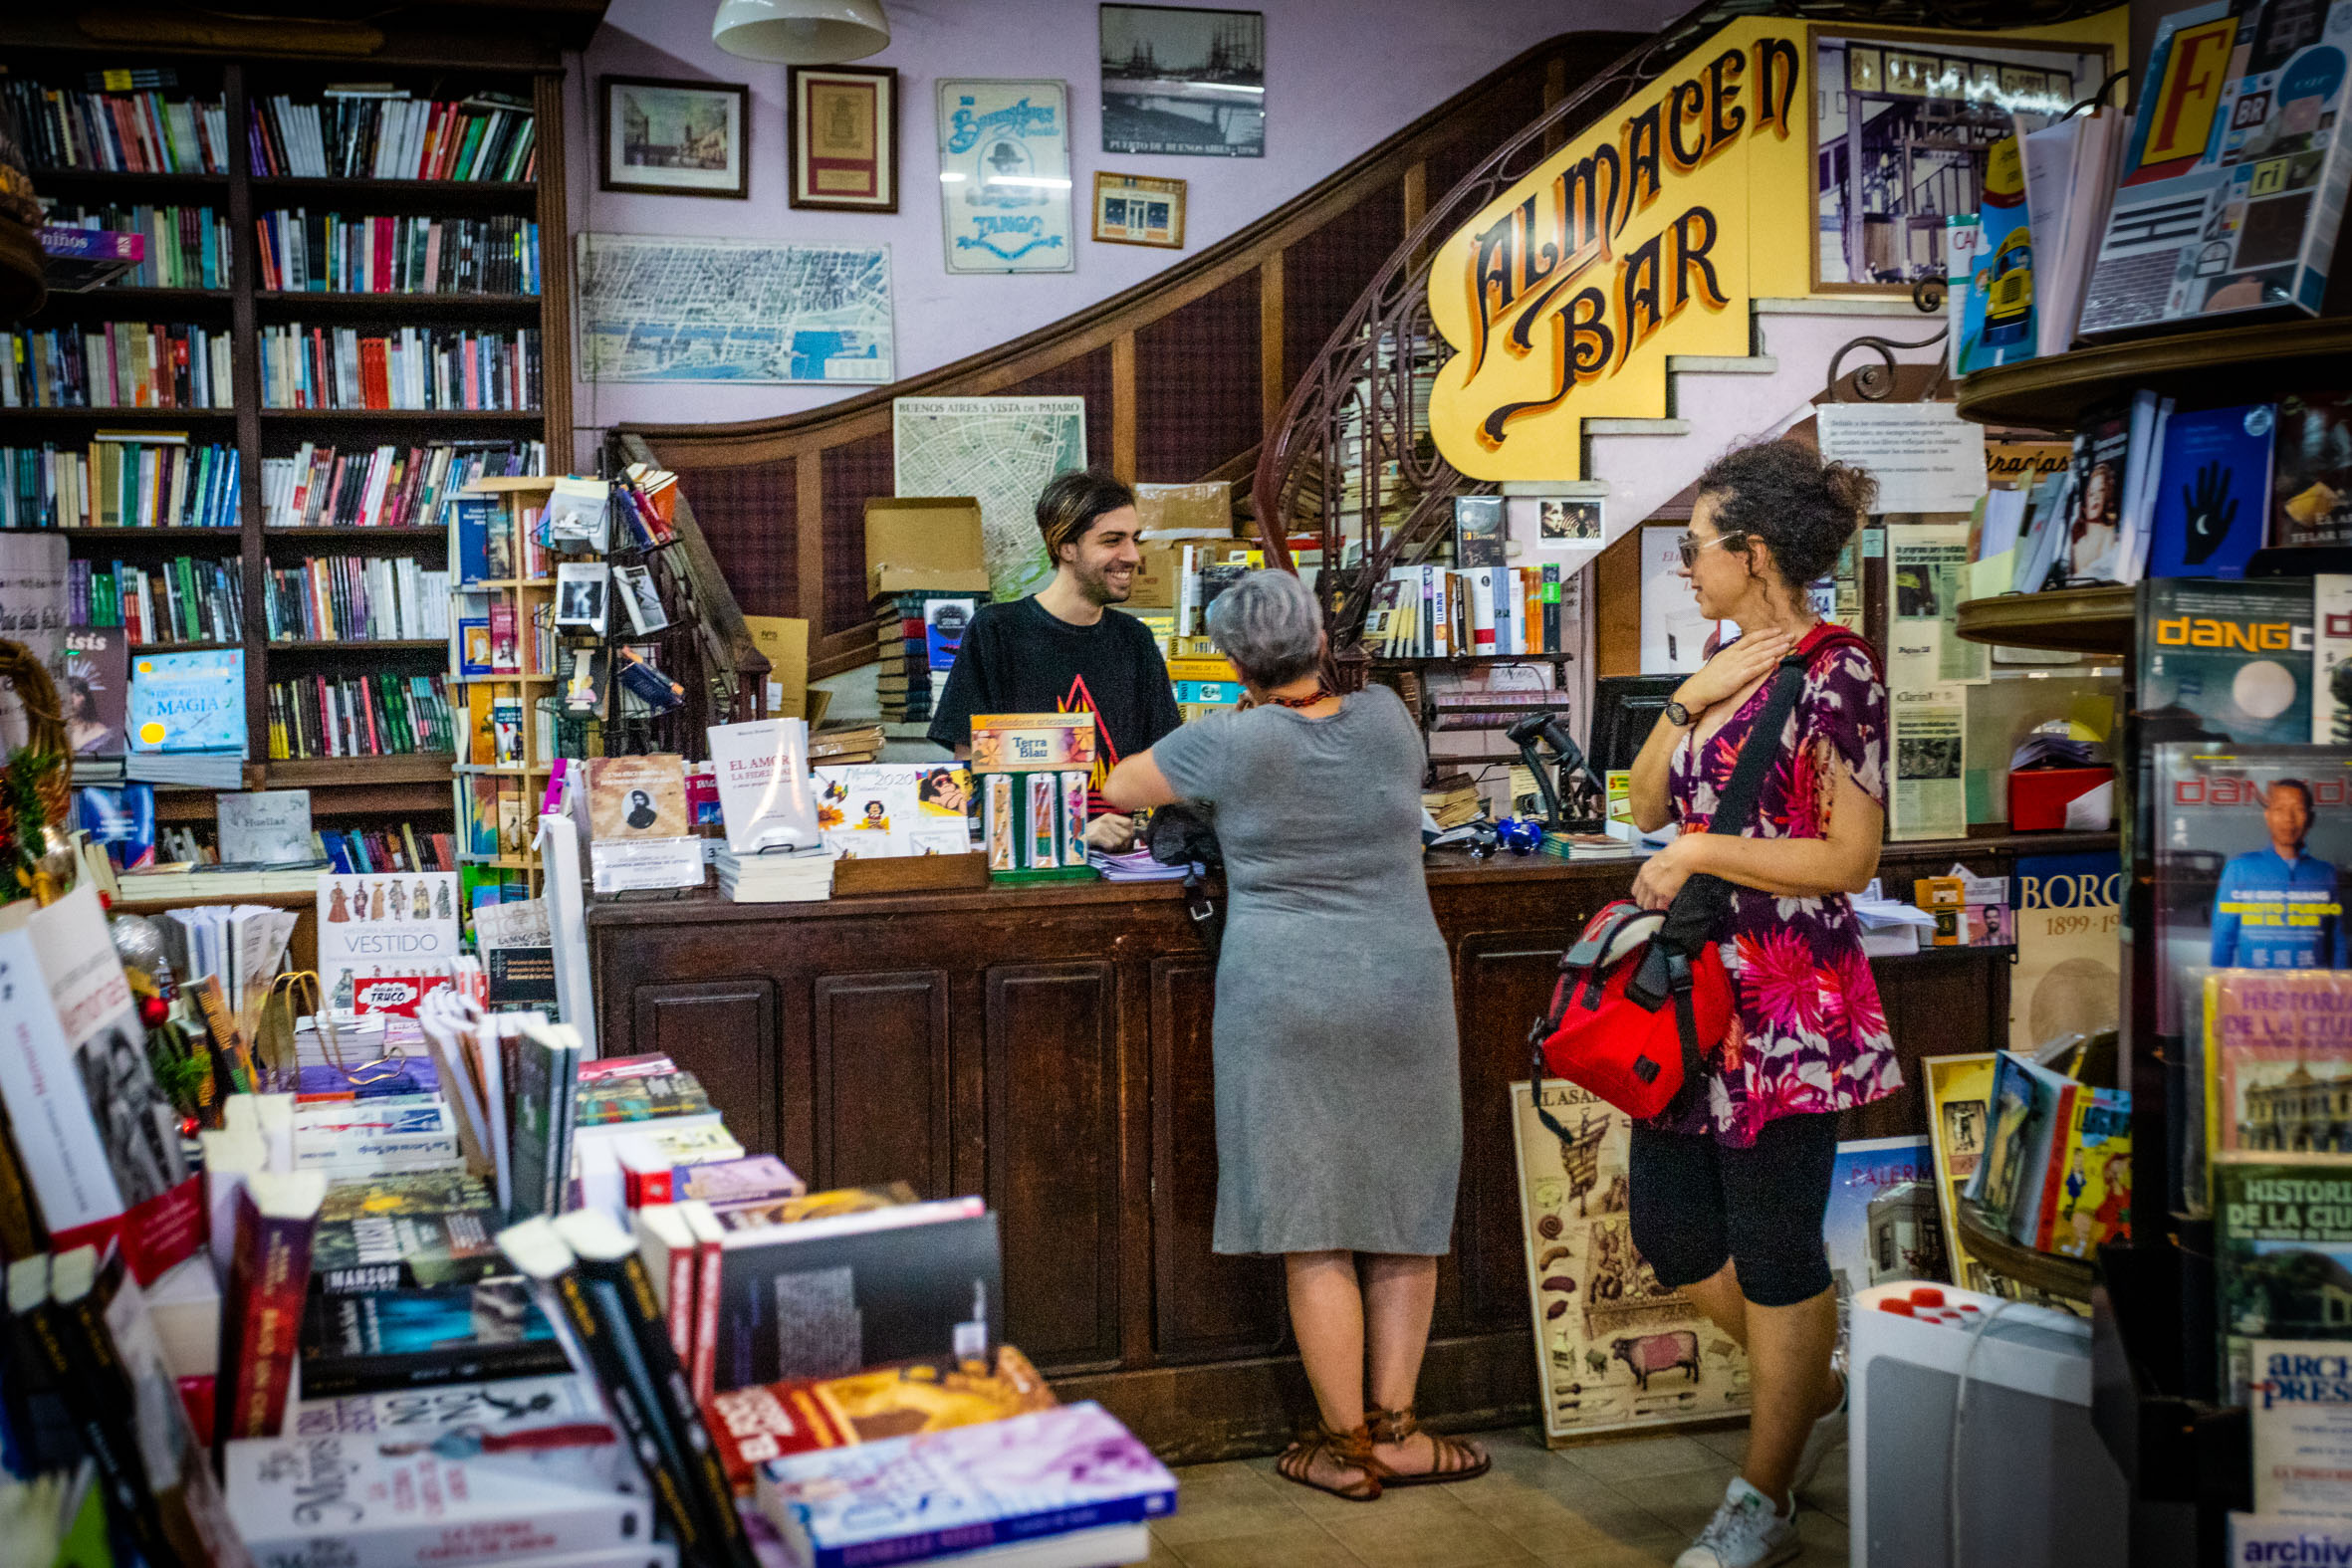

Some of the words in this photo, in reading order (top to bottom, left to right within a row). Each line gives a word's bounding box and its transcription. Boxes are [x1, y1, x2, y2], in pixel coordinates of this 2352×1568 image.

[1462, 38, 1800, 388] ALMACEN
[973, 215, 1044, 240] TANGO
[1484, 206, 1731, 440] BAR
[898, 403, 945, 413] BUENOS
[947, 403, 980, 413] AIRES
[990, 402, 1021, 413] VISTA
[156, 698, 219, 716] MAGIA
[1011, 737, 1048, 748] Terra
[1019, 747, 1048, 759] Blau
[730, 760, 747, 772] EL
[874, 774, 914, 787] 2020
[2046, 914, 2089, 936] 1899
[344, 933, 439, 954] VESTIDO
[370, 992, 406, 1004] TRUCO
[2227, 1203, 2261, 1227] DE
[2267, 1204, 2301, 1227] LA
